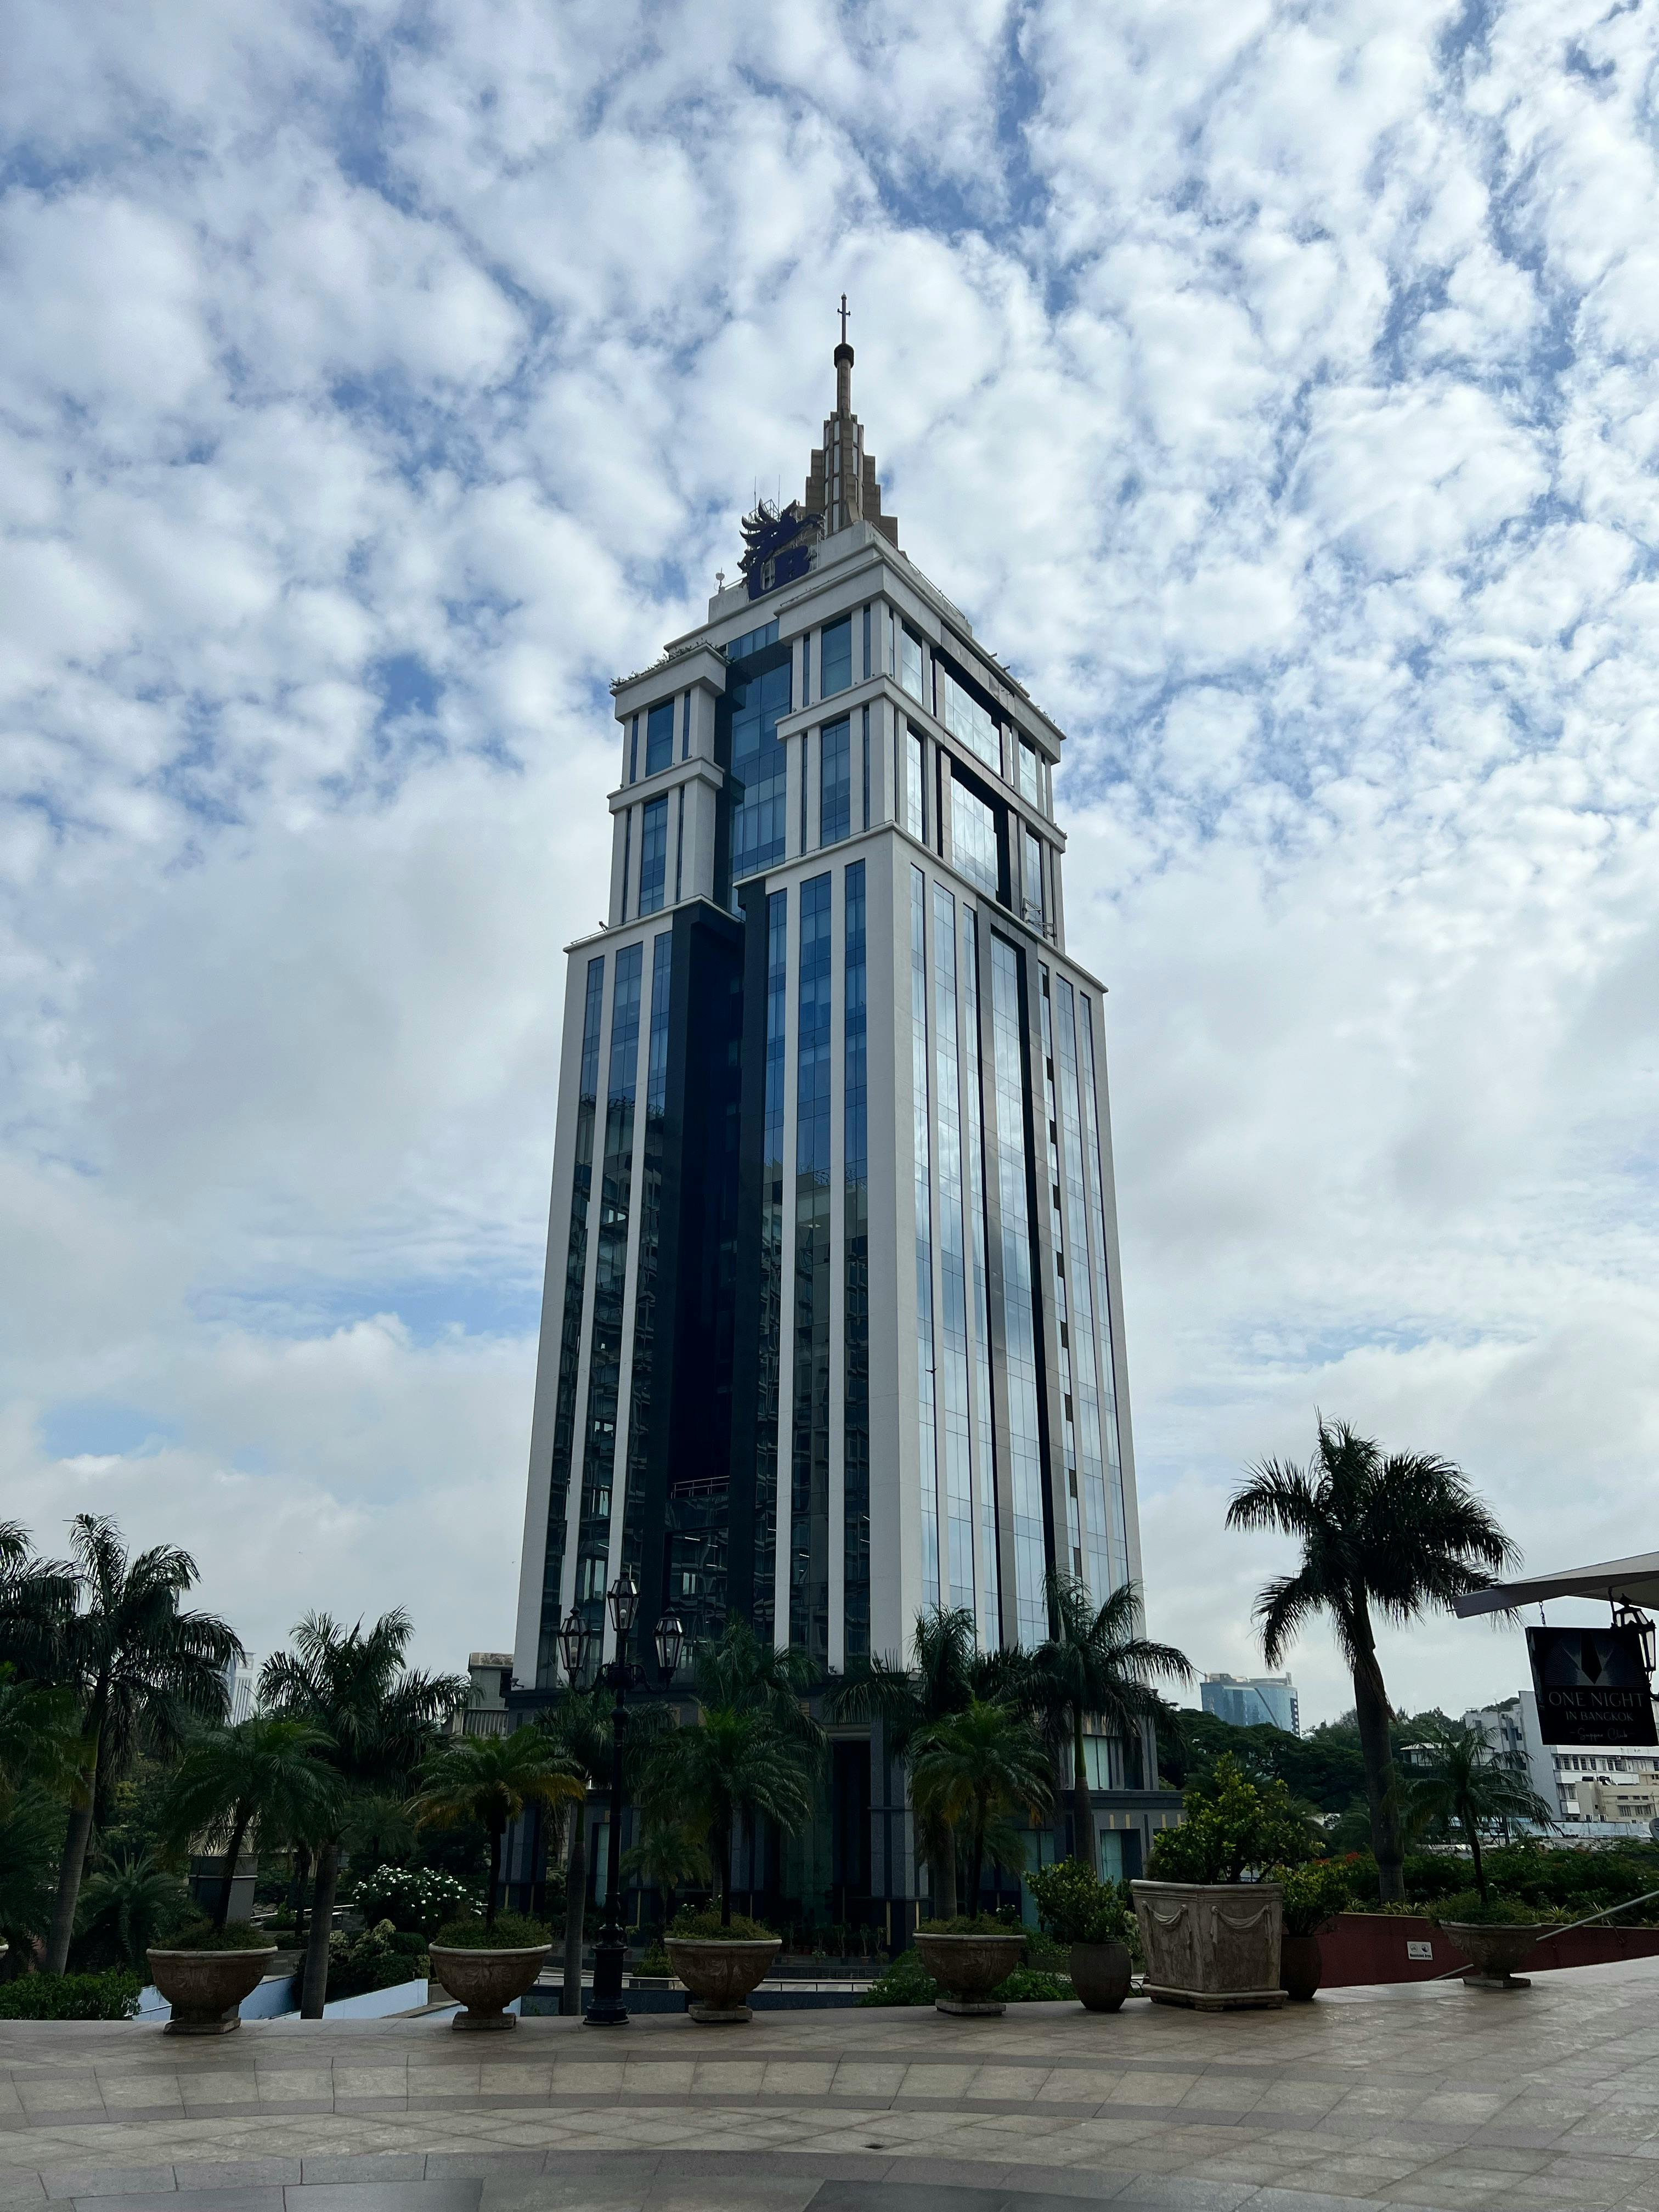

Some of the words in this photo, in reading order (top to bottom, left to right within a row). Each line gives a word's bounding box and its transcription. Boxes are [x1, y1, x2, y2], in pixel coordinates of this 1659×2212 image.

[748, 545, 810, 600] UB
[1549, 1691, 1586, 1706] ONE
[1590, 1692, 1644, 1707] NIGHT
[1566, 1711, 1577, 1720] IN
[1581, 1712, 1634, 1721] BANGKOK
[1607, 1728, 1628, 1740] Club
